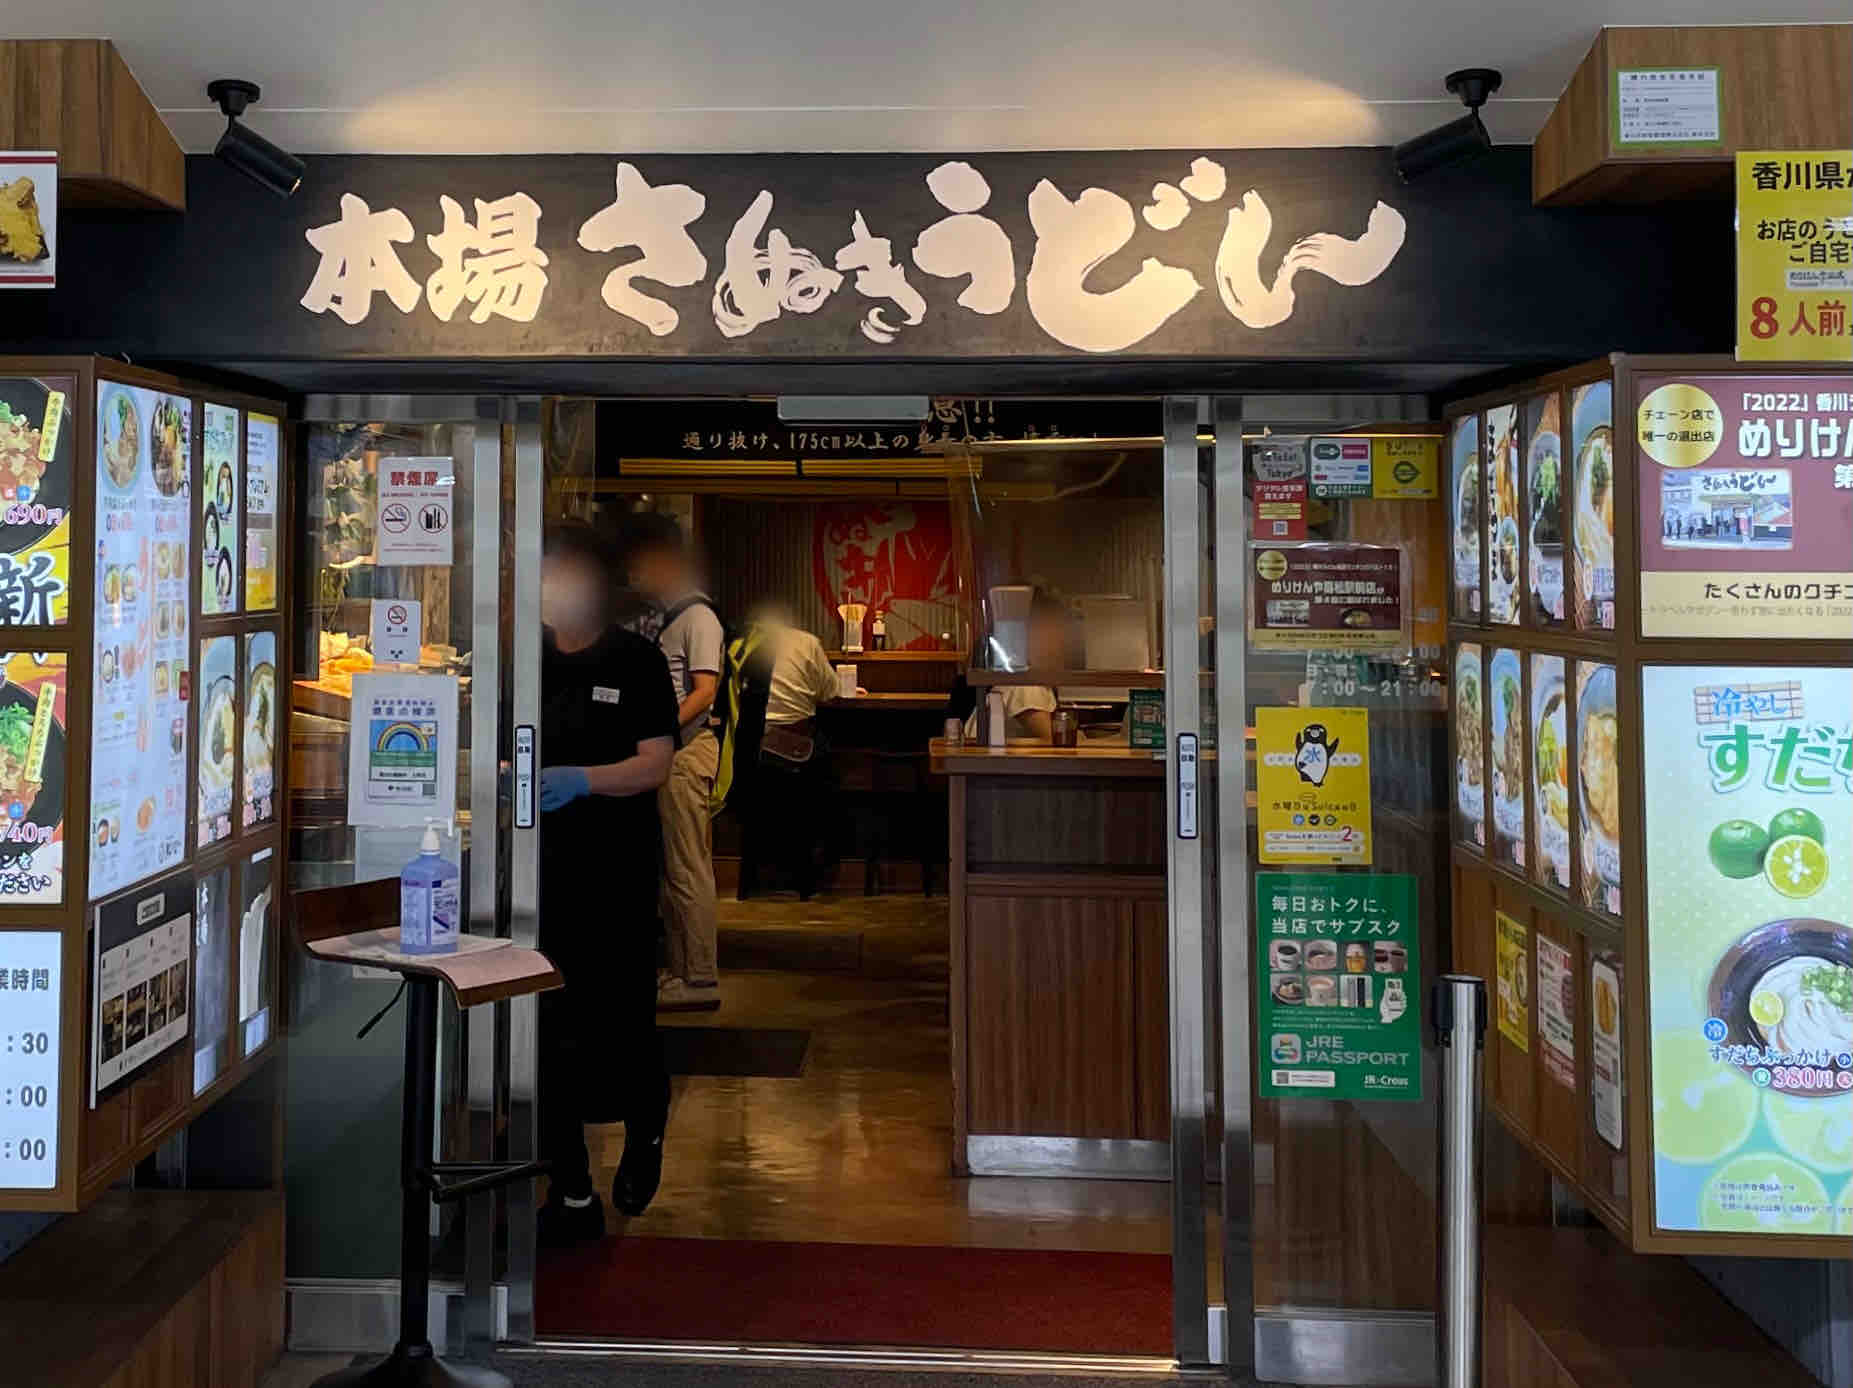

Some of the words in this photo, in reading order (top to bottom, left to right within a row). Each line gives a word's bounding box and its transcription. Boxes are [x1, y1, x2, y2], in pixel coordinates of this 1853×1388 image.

[1752, 161, 1853, 190] 香川県
[1643, 408, 1714, 421] チェーン店で
[682, 431, 1003, 450] 通り抜け、175cm以上の
[1712, 688, 1788, 717] 冷やし
[1303, 747, 1321, 763] 水
[1271, 896, 1388, 913] 毎日おトクに、
[1271, 918, 1400, 936] 当店でサブスク
[1306, 1036, 1344, 1048] JRE
[1306, 1052, 1409, 1065] PASSPORT
